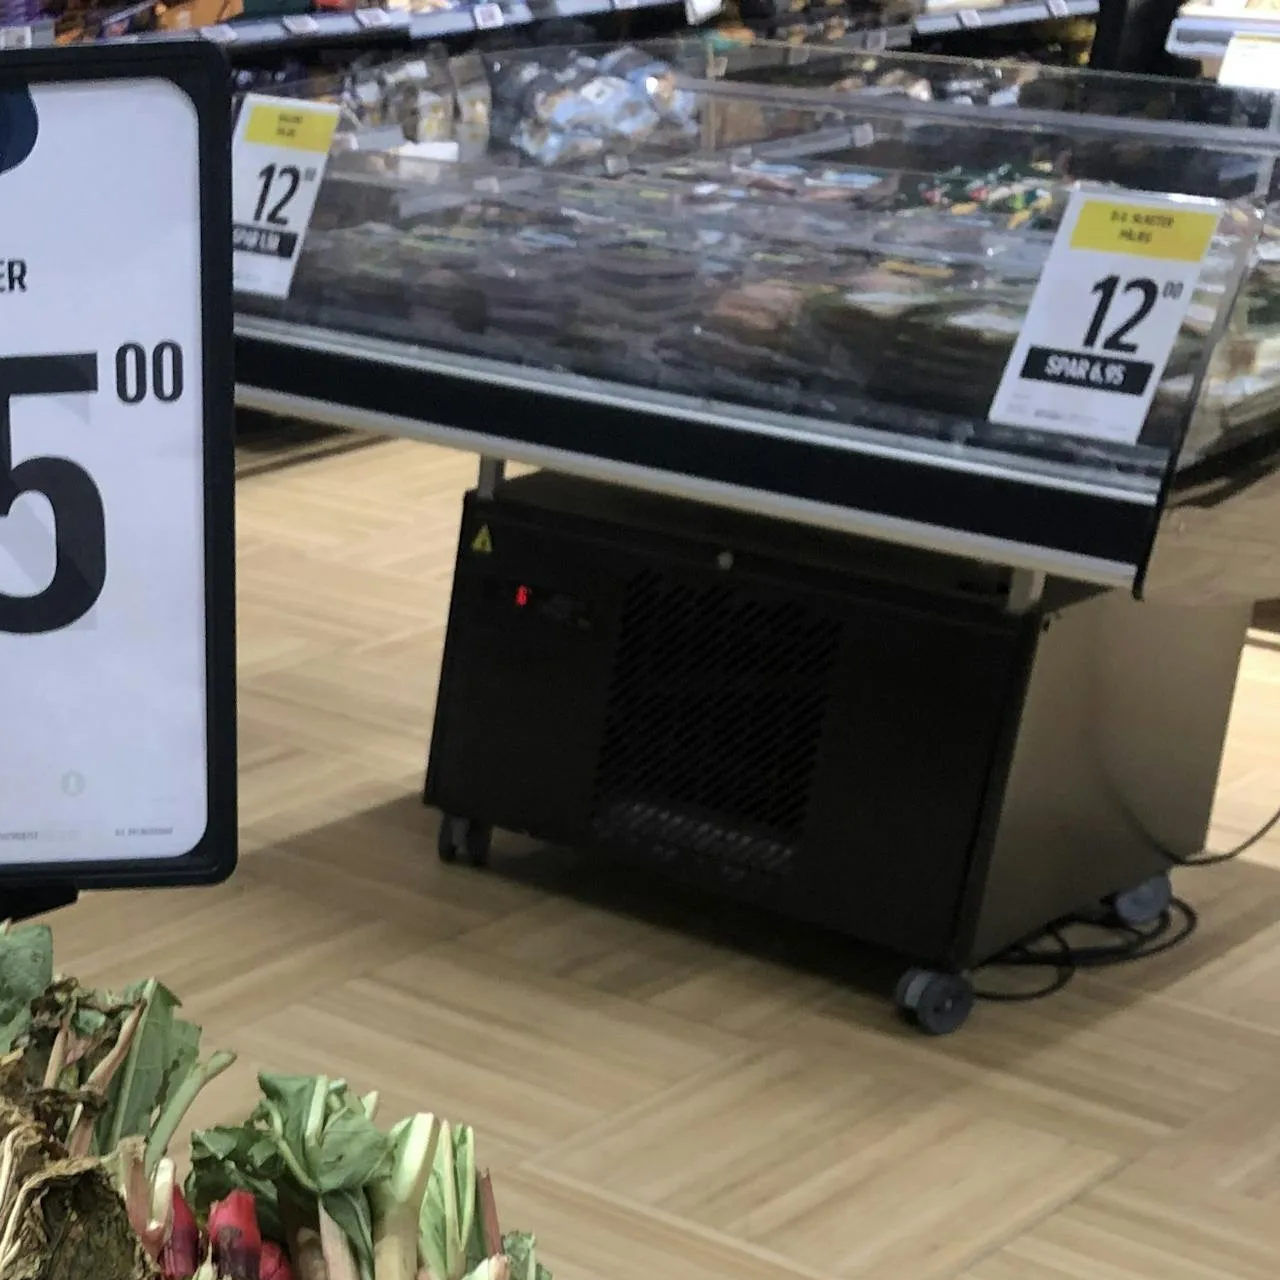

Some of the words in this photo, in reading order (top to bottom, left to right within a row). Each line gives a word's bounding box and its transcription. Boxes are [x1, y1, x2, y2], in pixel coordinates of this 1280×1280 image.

[253, 163, 300, 225] 12
[1082, 275, 1159, 354] 12
[115, 340, 185, 404] 00
[1044, 355, 1090, 382] SPAR
